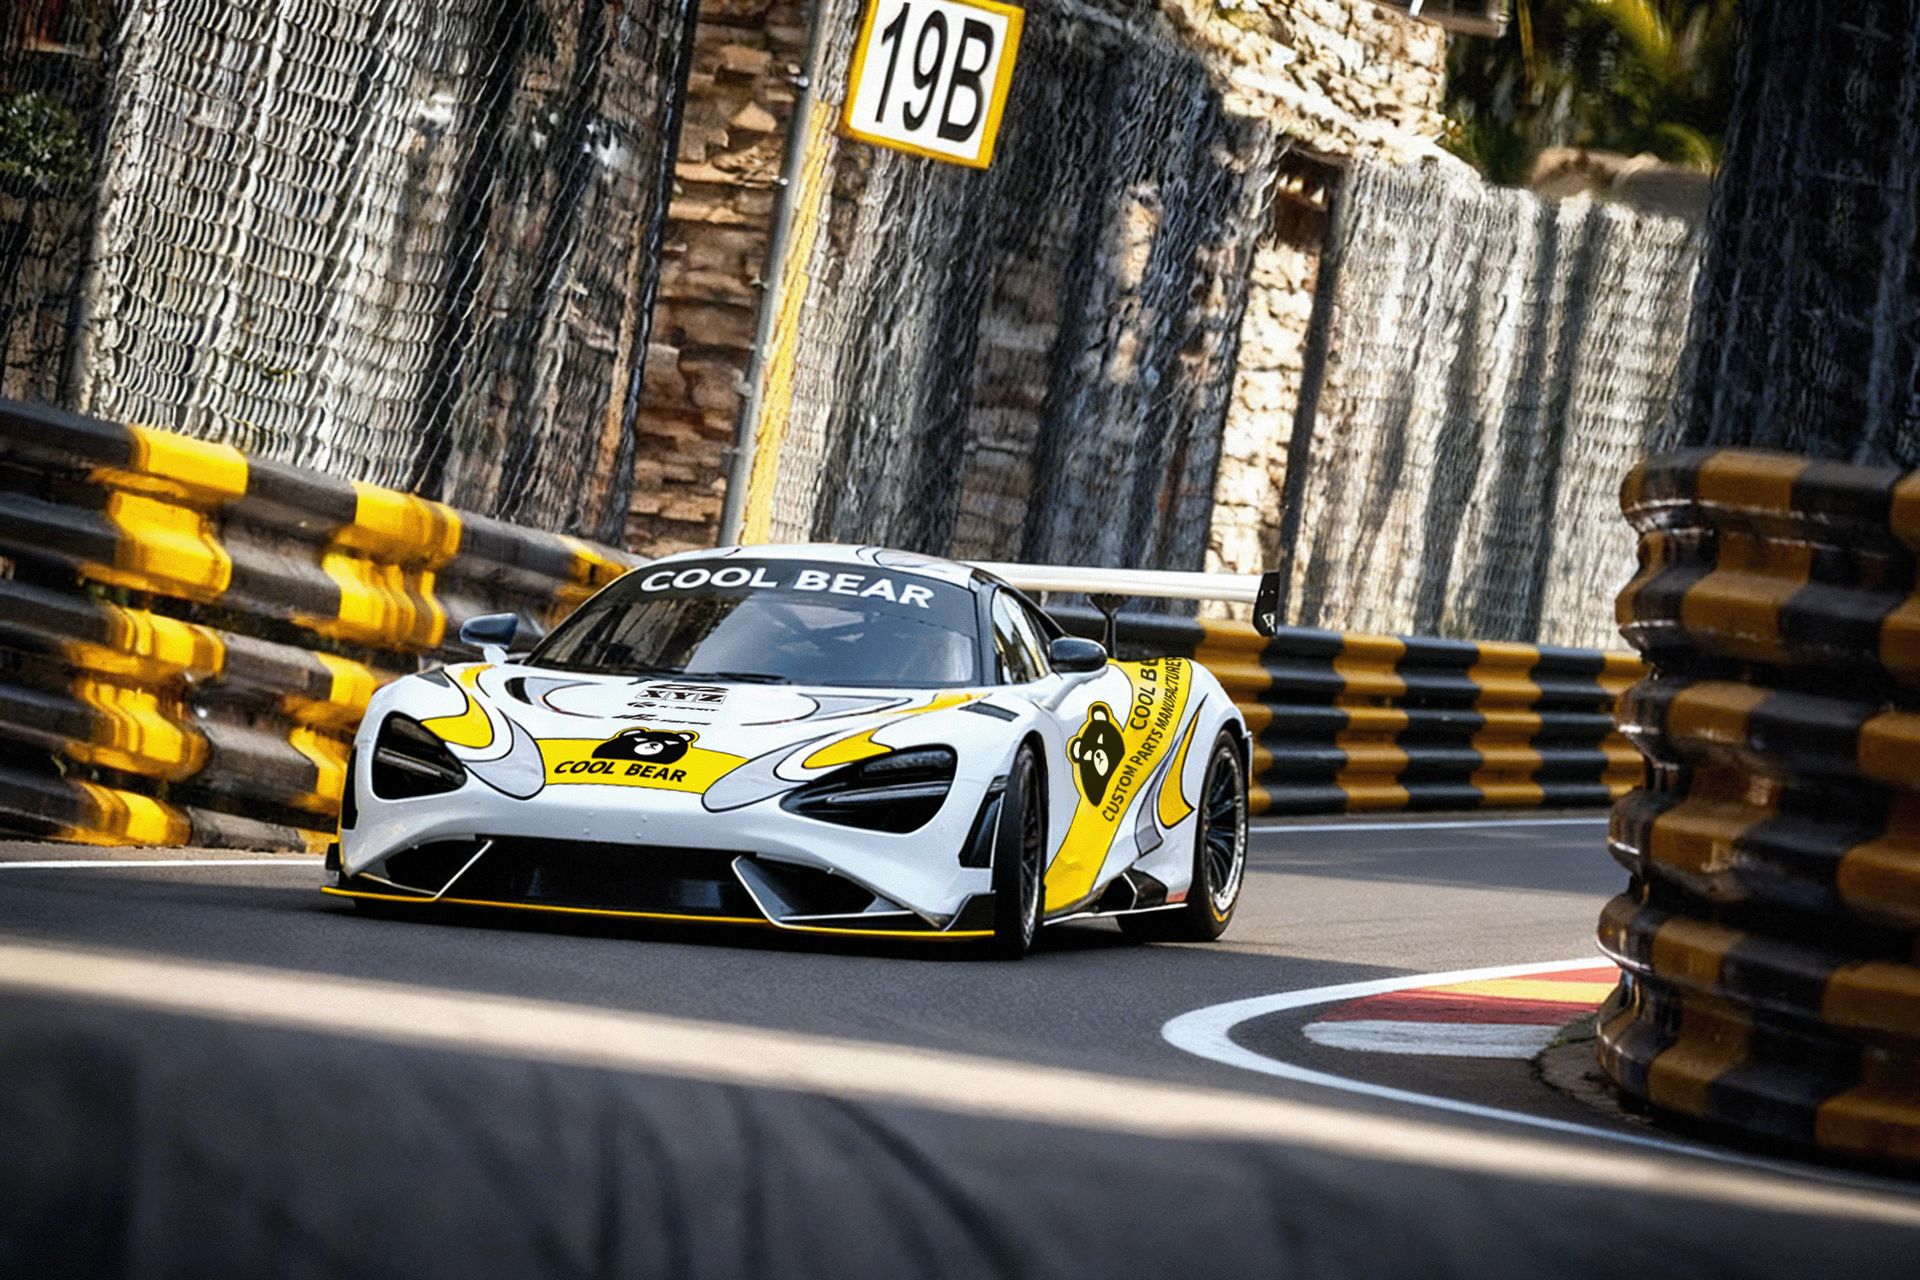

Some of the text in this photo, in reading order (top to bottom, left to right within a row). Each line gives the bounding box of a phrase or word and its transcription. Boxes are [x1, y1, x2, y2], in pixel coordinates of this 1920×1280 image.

[875, 2, 994, 143] 19B
[641, 567, 935, 609] COOL BEAR
[639, 689, 724, 703] XYZ
[1130, 687, 1156, 730] COOL
[554, 761, 687, 782] COOL BEAR
[1102, 765, 1137, 822] CUSTOM
[1130, 730, 1164, 766] PARTS
